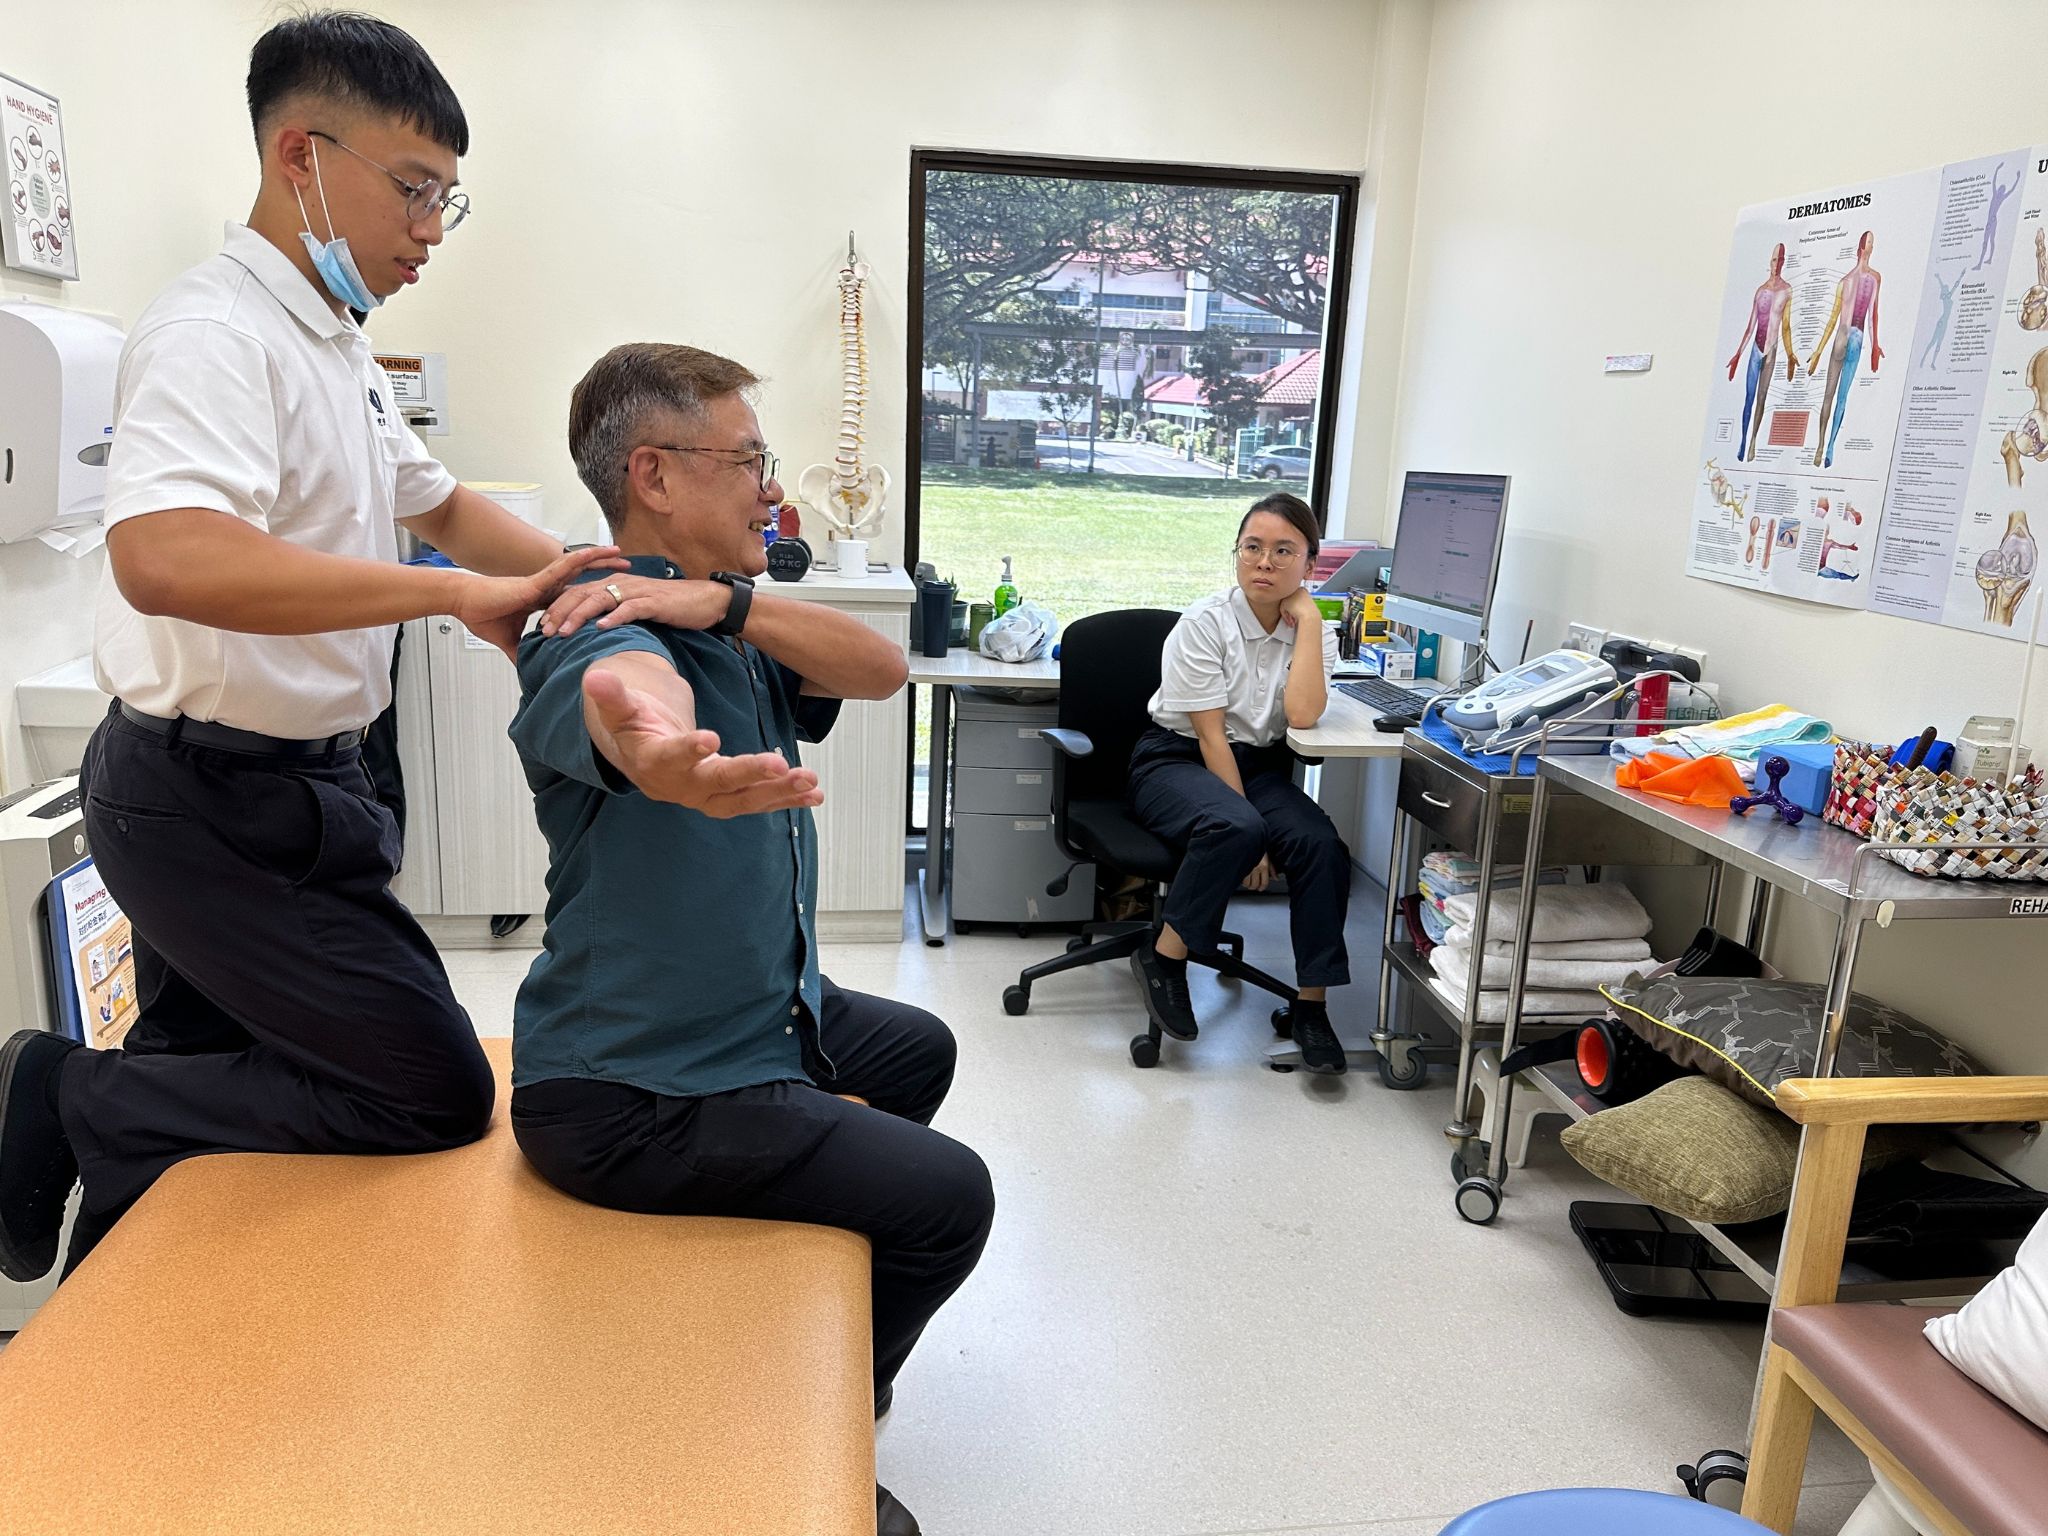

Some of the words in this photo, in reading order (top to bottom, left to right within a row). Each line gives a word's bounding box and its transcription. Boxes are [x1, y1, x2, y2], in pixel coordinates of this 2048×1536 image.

[6, 95, 26, 113] HAND
[26, 104, 53, 126] HYGIENE
[1787, 193, 1872, 220] DERMATOMES
[374, 359, 420, 371] ARNING
[787, 559, 801, 568] KG
[75, 888, 107, 914] Managing
